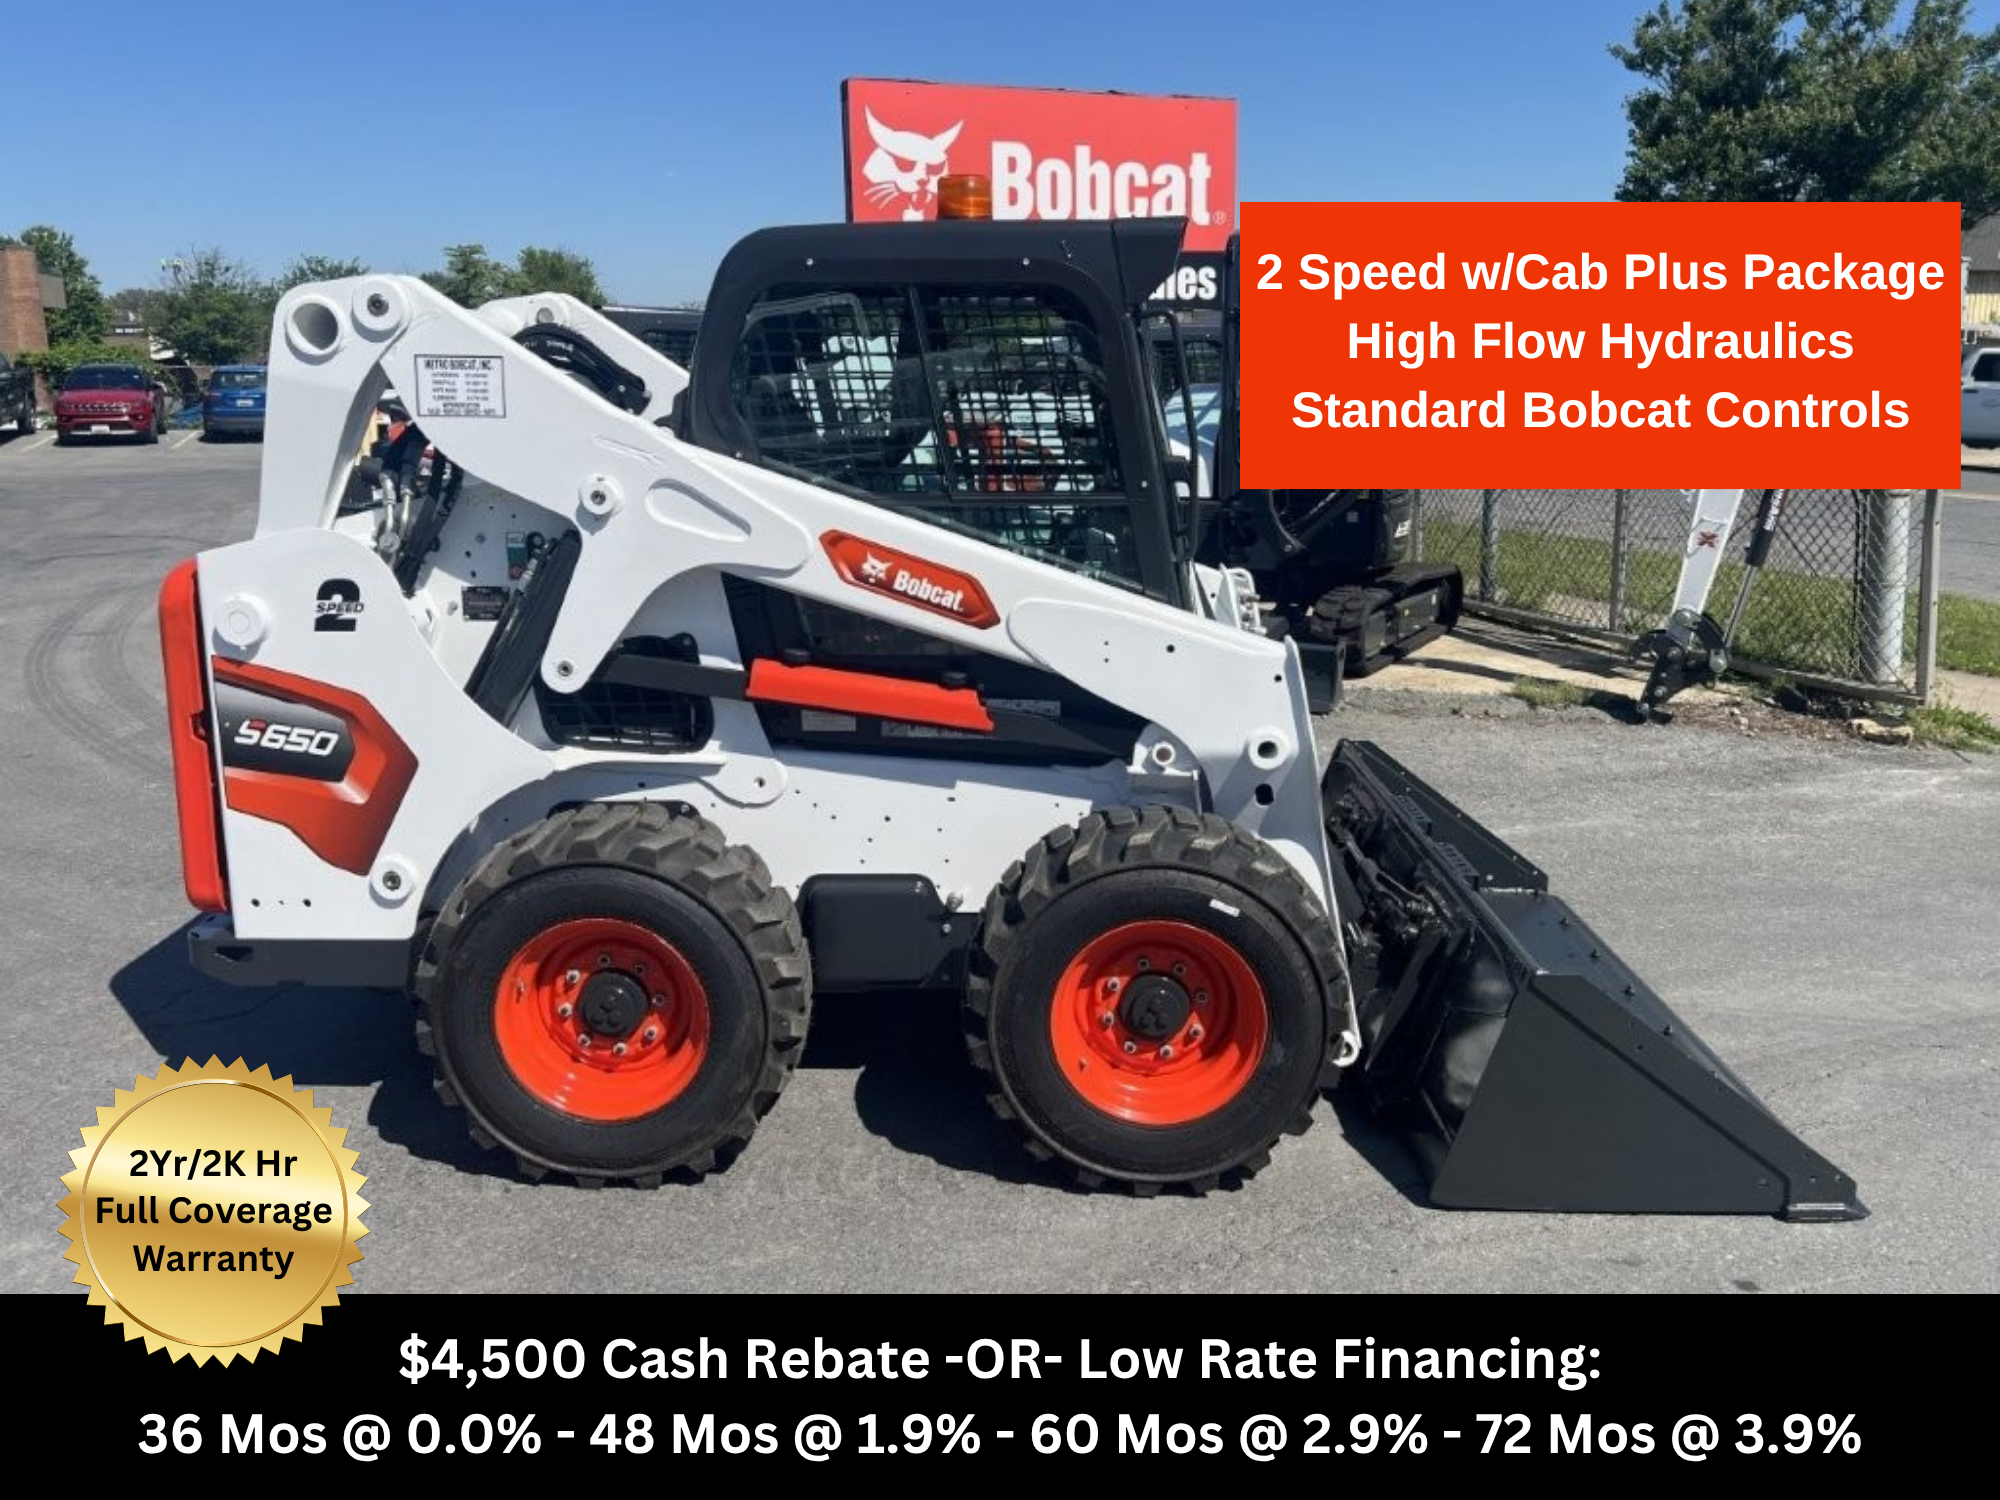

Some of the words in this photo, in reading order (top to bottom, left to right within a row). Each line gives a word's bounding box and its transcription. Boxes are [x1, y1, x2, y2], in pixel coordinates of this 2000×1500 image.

[991, 141, 1212, 226] Bobcat
[314, 578, 361, 632] 2
[315, 602, 364, 614] SPEED
[893, 569, 964, 612] Bobcat
[234, 719, 339, 757] S650
